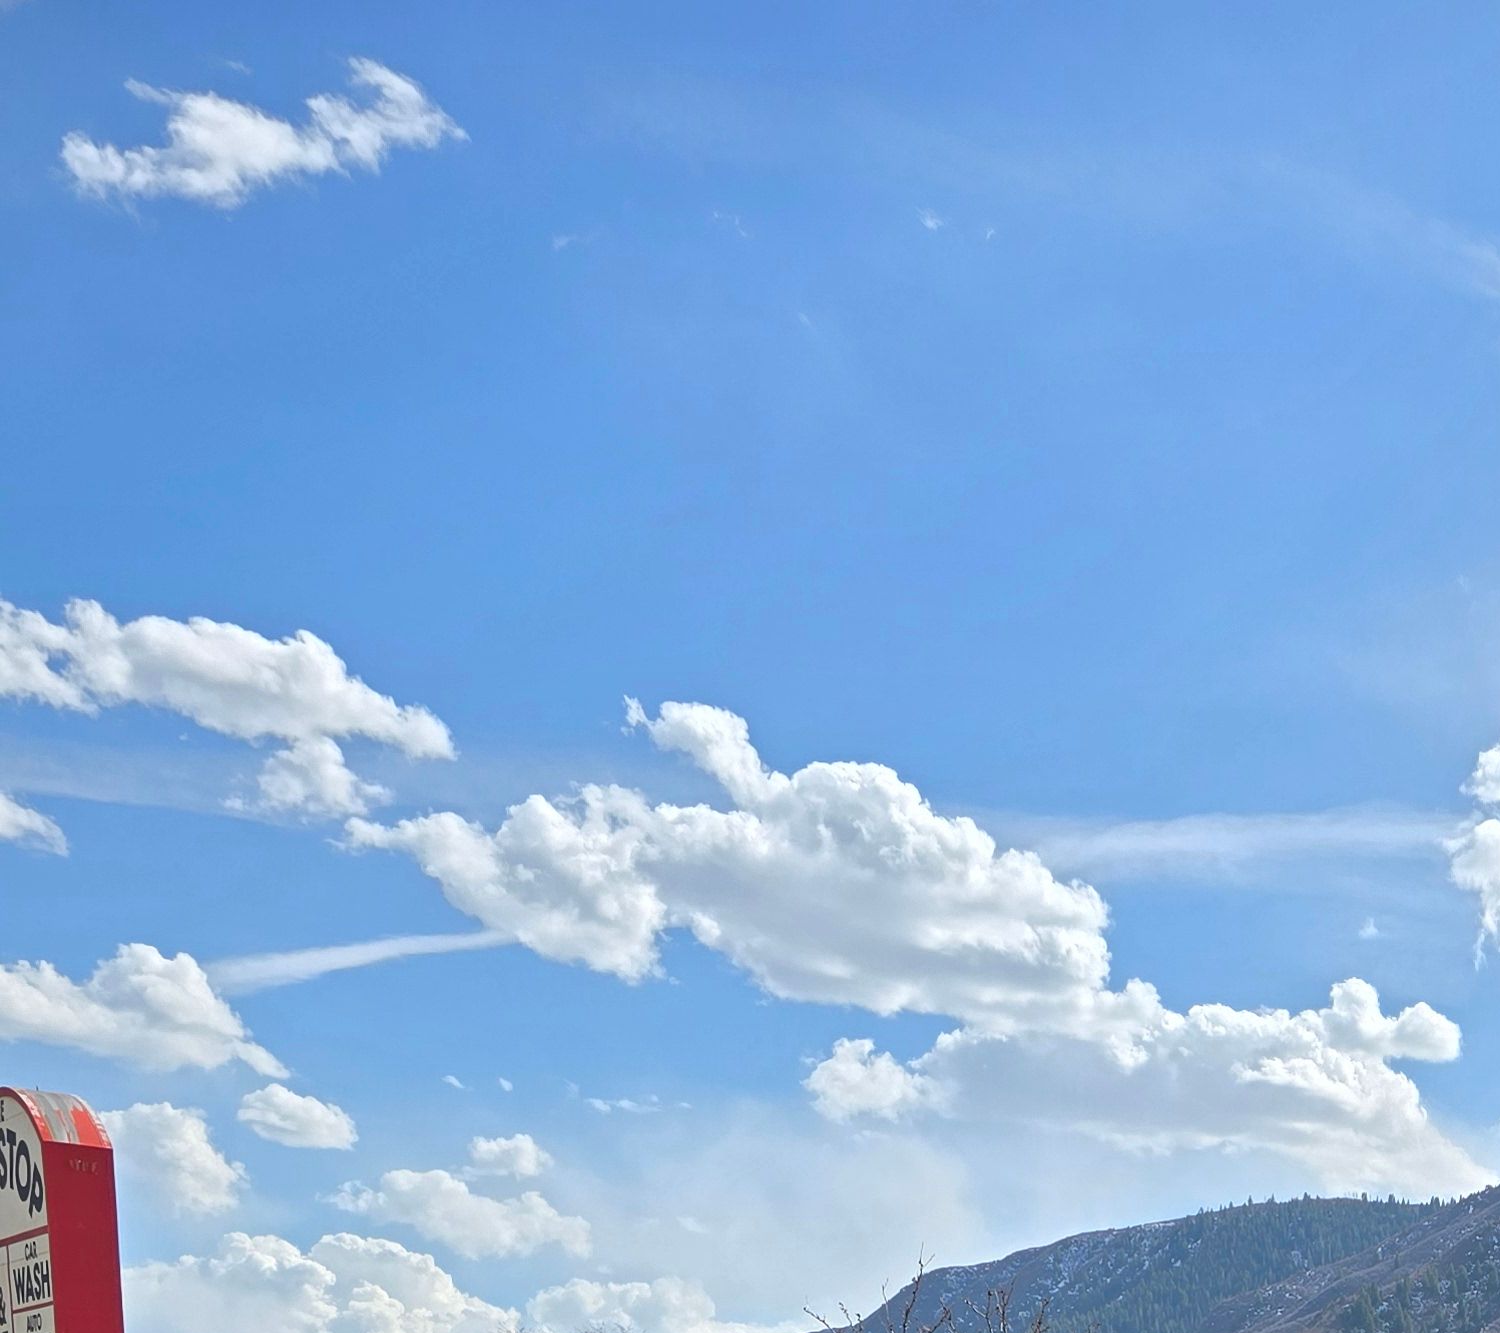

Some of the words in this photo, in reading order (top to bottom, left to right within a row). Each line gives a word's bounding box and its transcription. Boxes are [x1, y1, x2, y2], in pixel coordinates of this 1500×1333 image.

[24, 1240, 38, 1261] CAR
[12, 1259, 51, 1305] WASH
[26, 1312, 42, 1333] AUTO
